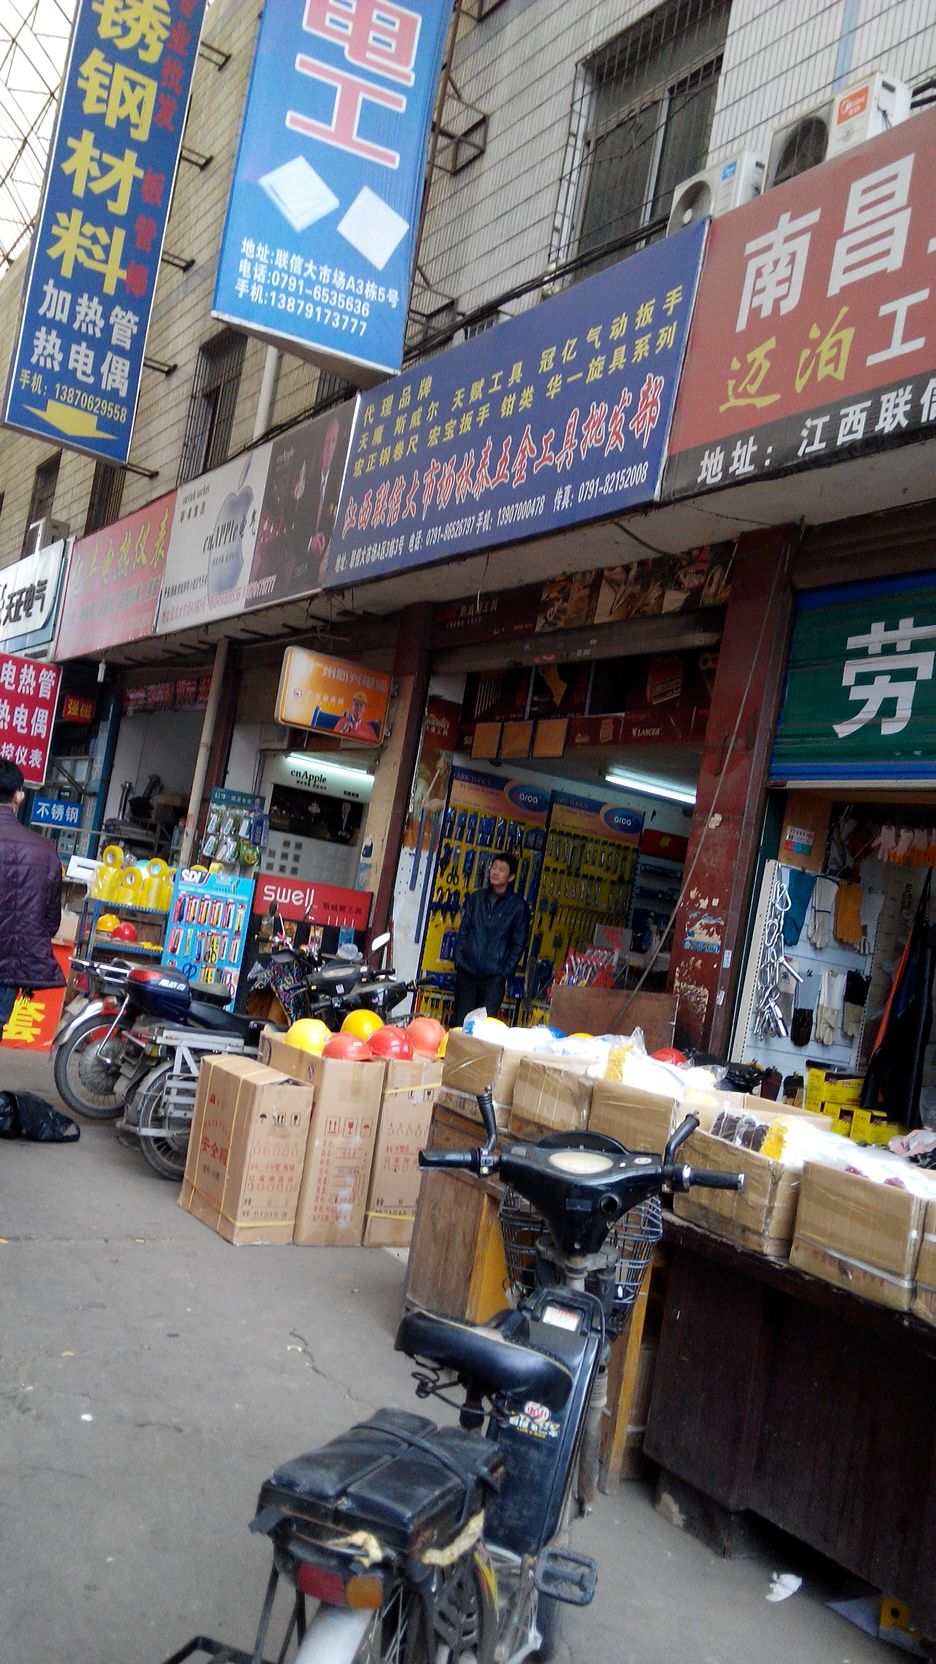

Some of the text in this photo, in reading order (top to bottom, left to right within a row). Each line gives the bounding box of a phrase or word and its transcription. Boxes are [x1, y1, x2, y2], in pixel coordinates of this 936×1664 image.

[736, 153, 936, 333] 南昌
[39, 279, 140, 351] 加热管
[234, 278, 368, 337] 手机:13879173777
[238, 258, 370, 318] 电话:0791-6535636
[30, 325, 131, 397] 热电偶
[363, 375, 433, 428] 代理品牌
[0, 659, 57, 701] 电热管
[832, 616, 936, 739] 劳
[36, 801, 80, 824] 不锈钢
